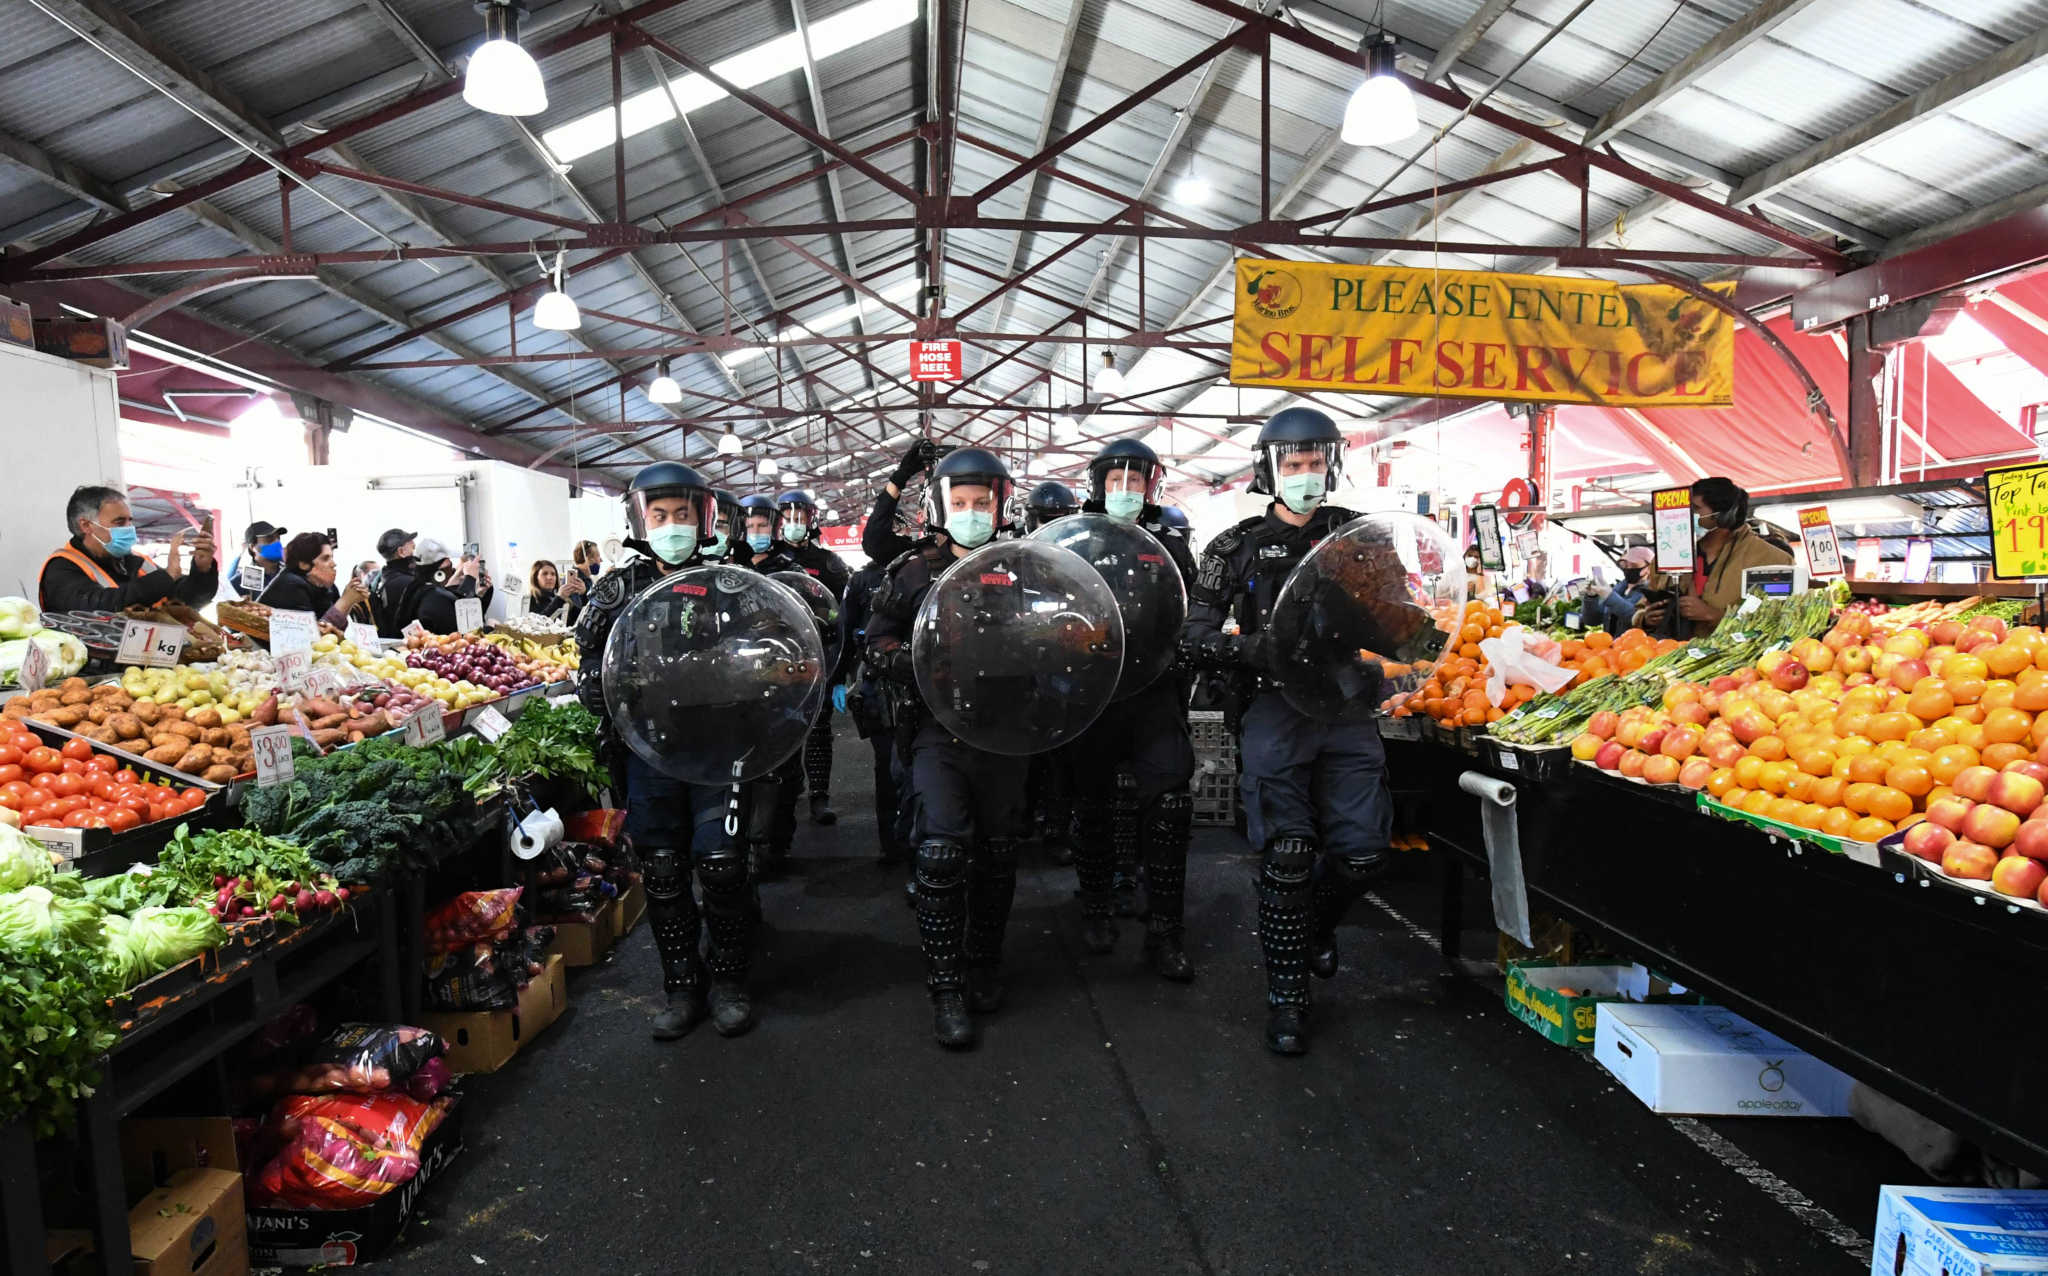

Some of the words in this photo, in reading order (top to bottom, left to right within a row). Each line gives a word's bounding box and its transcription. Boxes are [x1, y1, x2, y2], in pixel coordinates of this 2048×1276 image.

[1331, 277, 1491, 317] PLEASE
[921, 343, 949, 352] FIRE
[919, 352, 952, 362] HOSE
[1259, 331, 1422, 385] SELF
[1433, 339, 1714, 398] SERVICE
[920, 362, 952, 372] REEL
[1655, 489, 1691, 509] SPECIAL
